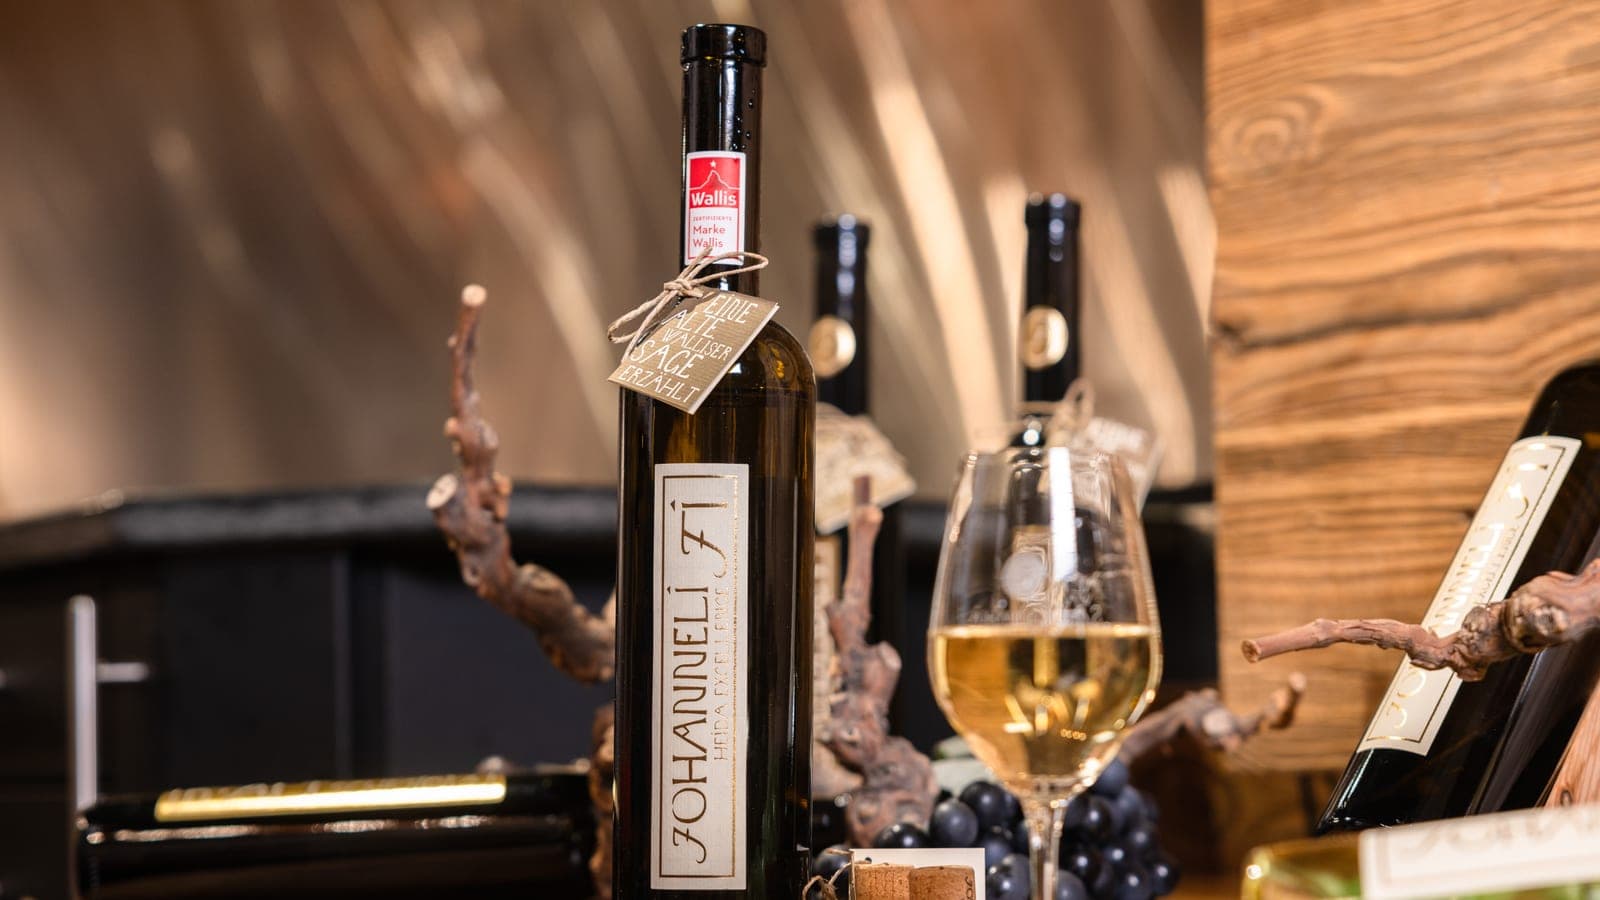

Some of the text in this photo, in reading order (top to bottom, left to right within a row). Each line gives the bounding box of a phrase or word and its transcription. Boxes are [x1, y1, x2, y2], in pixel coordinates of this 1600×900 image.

[691, 189, 737, 206] Wallis
[693, 224, 727, 235] Marke
[693, 237, 724, 248] Wallis
[661, 309, 726, 340] ALTE
[703, 293, 759, 324] EINE
[629, 339, 705, 379] SAGE
[662, 328, 733, 361] WALLISER
[618, 364, 700, 403] ERZÄHLT
[667, 586, 709, 864] JOHANNELI
[711, 704, 729, 761] HEIDA
